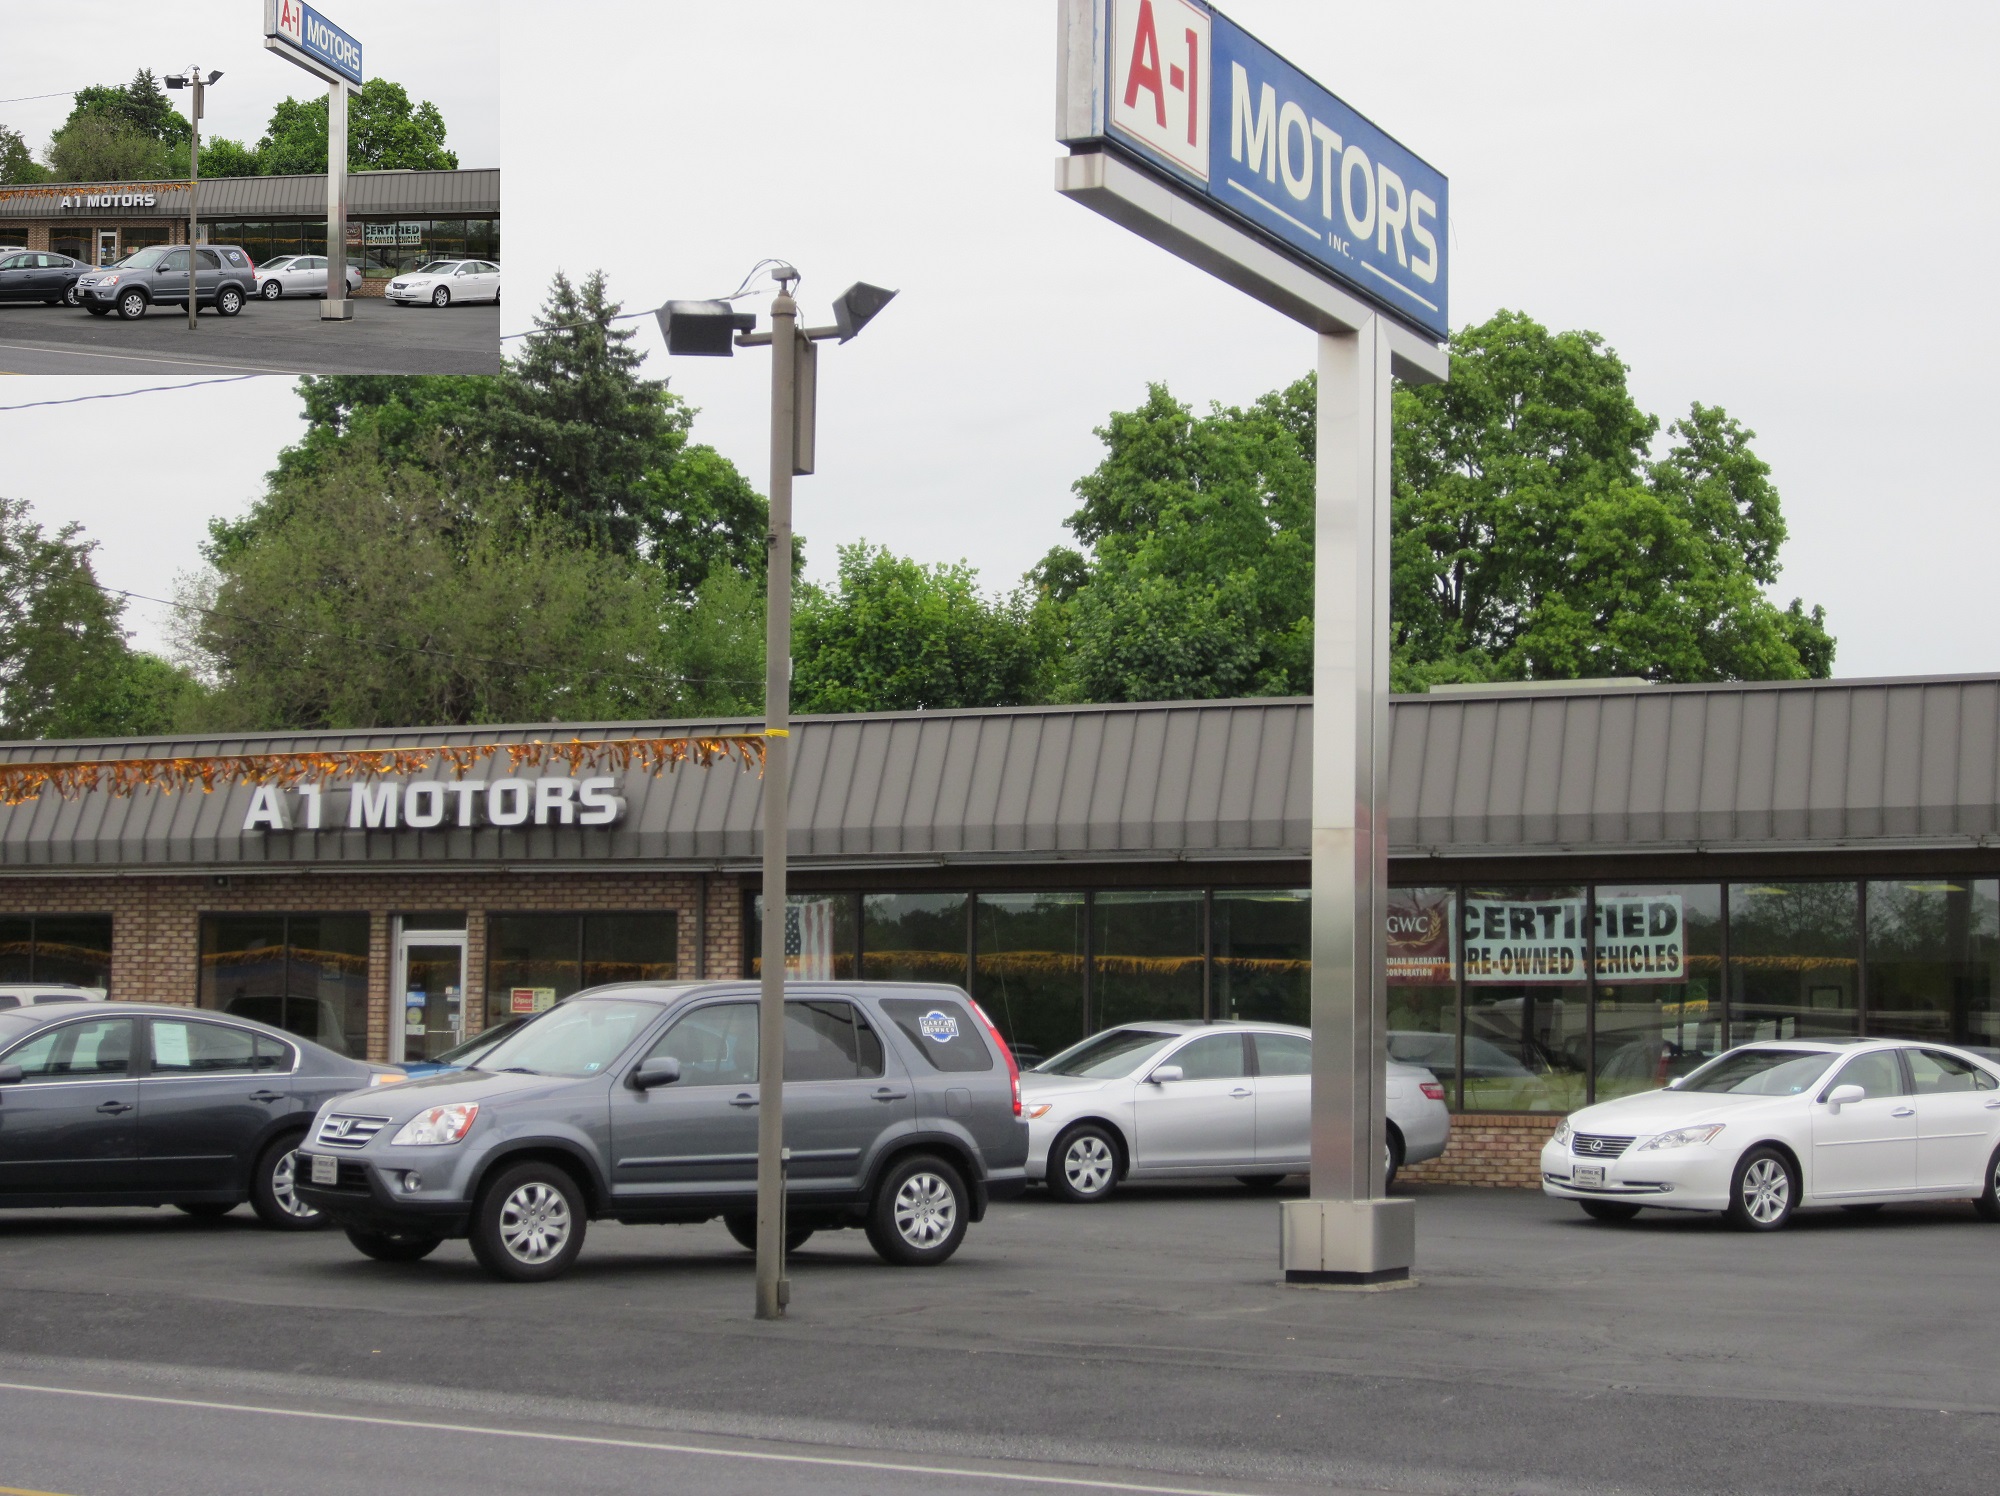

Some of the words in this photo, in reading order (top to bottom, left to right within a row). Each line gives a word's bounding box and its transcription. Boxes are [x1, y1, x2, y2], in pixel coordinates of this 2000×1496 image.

[281, 0, 300, 36] A-1
[308, 15, 360, 71] MOTORS
[1124, 0, 1198, 148] A-1
[1231, 60, 1438, 284] MOTORS
[60, 196, 70, 207] A
[87, 194, 155, 207] MOTORS
[1328, 231, 1354, 260] INC.
[242, 785, 285, 830] A
[298, 784, 321, 829] 1
[349, 776, 619, 829] MOTORS
[1386, 916, 1428, 933] GWC
[1462, 903, 1678, 940] CERTIFIED
[1408, 956, 1446, 964] WARRANTY
[1463, 946, 1575, 975] RE-OWNED
